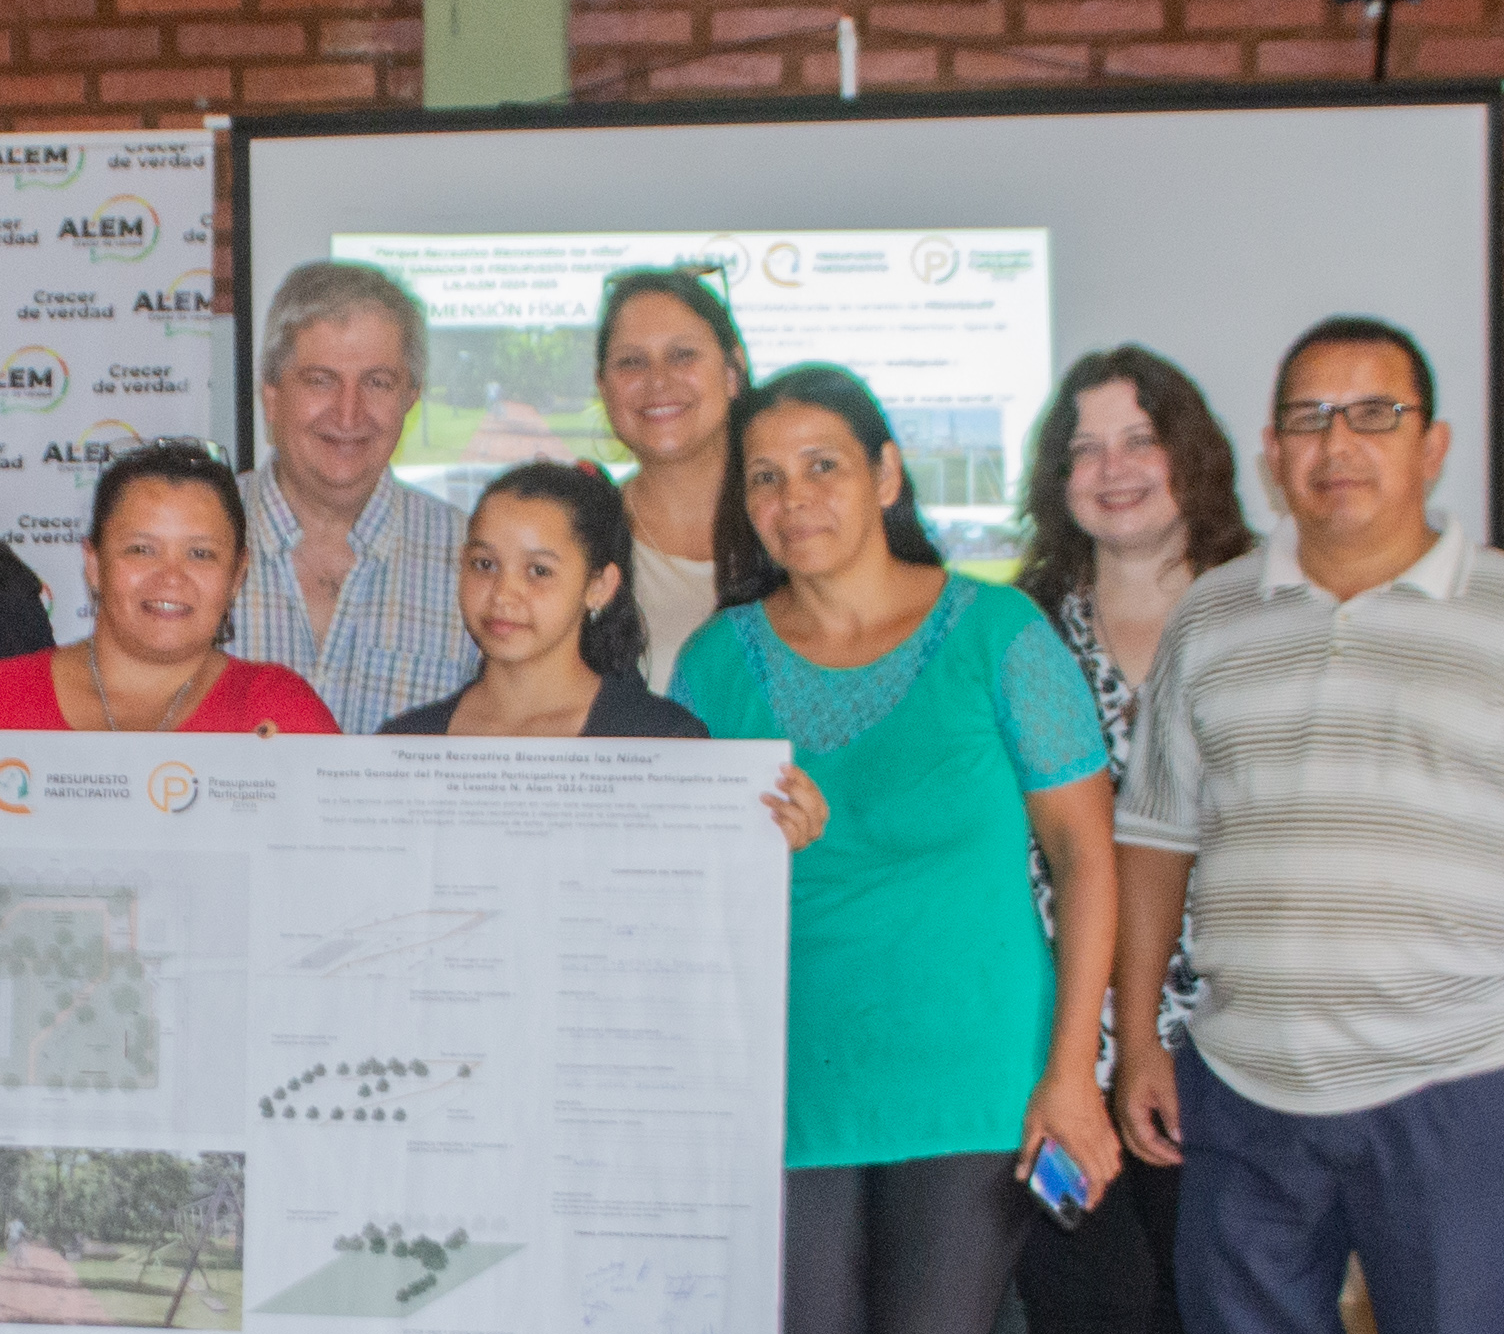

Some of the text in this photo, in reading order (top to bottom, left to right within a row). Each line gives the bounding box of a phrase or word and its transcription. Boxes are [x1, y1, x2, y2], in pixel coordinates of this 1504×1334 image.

[108, 152, 205, 169] de verdad
[57, 216, 144, 238] ALEM
[183, 228, 208, 244] de
[32, 289, 97, 304] Crecer
[17, 303, 115, 319] de verdad
[108, 363, 172, 378] Crecer
[92, 377, 189, 394] de verdad
[18, 514, 82, 529] Crecer
[515, 751, 590, 763] Bienvenidos
[594, 752, 612, 763] los
[45, 773, 129, 785] PRESUPUESTO
[208, 776, 277, 789] Presupuesto
[44, 787, 131, 799] PARTICIPATIVO
[208, 787, 277, 800] Participativo
